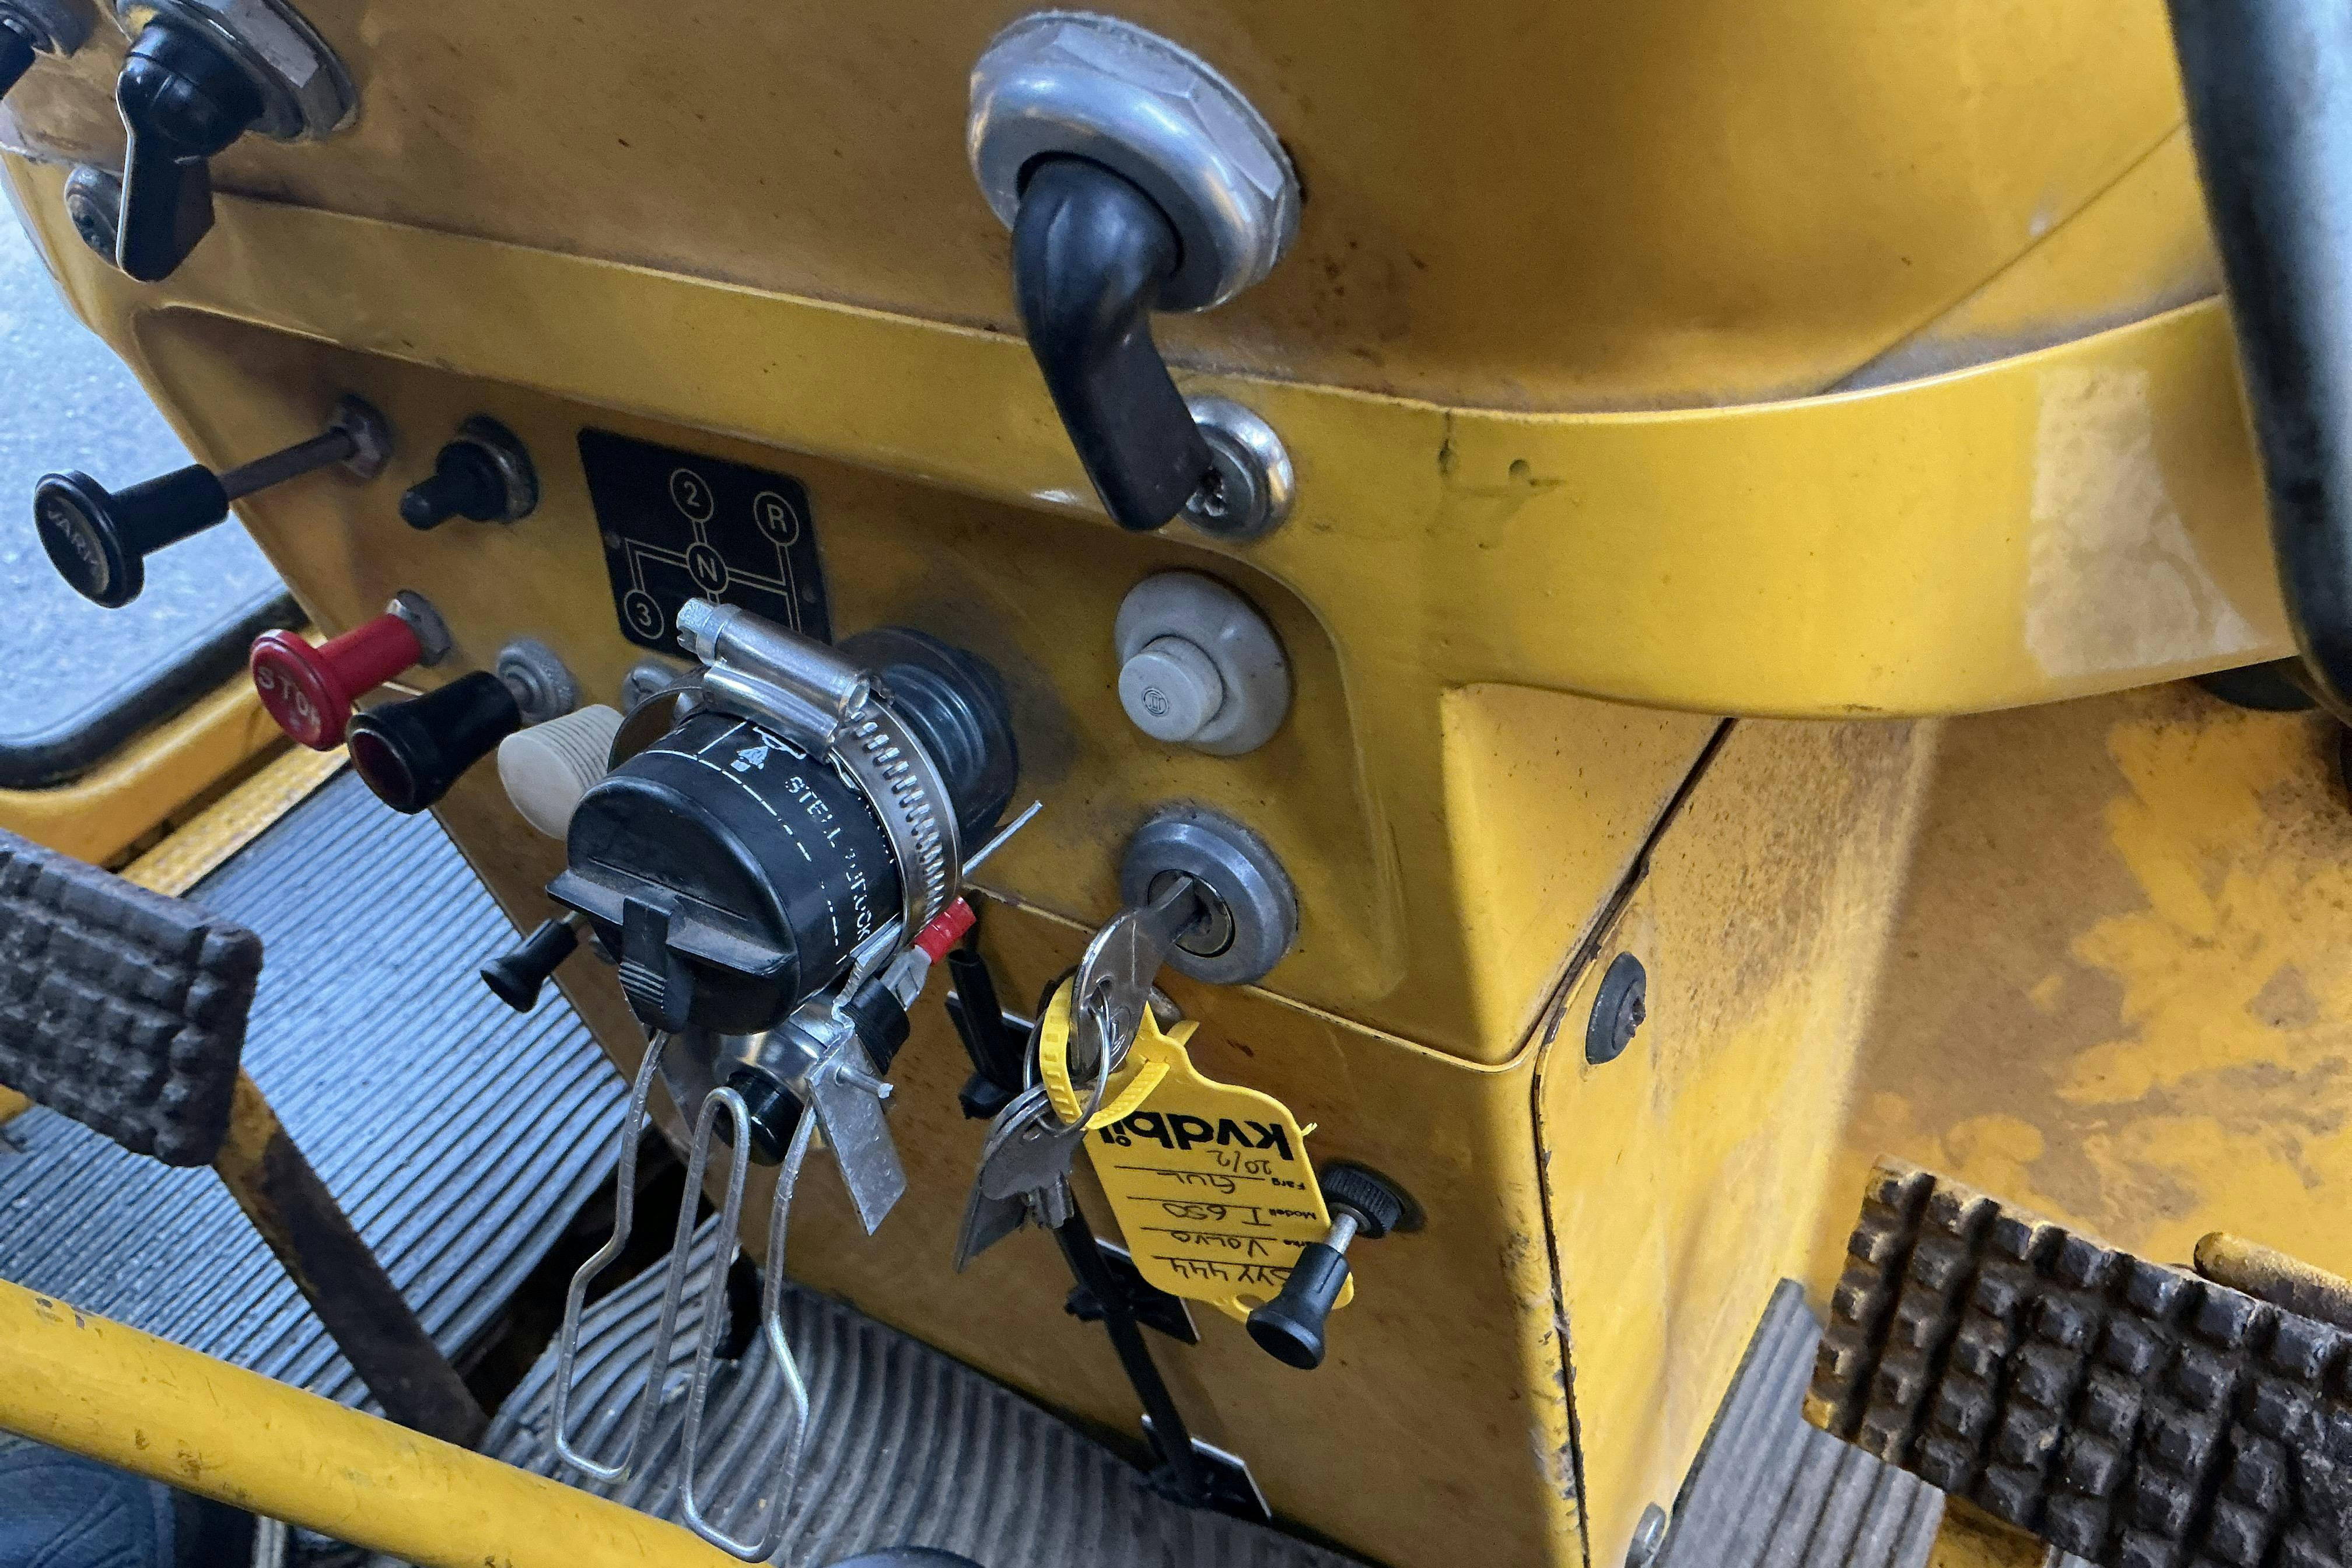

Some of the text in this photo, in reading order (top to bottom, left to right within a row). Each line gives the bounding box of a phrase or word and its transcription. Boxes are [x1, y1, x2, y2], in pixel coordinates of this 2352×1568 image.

[683, 480, 700, 508] 2
[766, 503, 788, 533] R
[696, 553, 718, 583] N
[636, 602, 652, 626] 3
[1161, 1202, 1228, 1220] 650
[1169, 1258, 1229, 1282] 444
